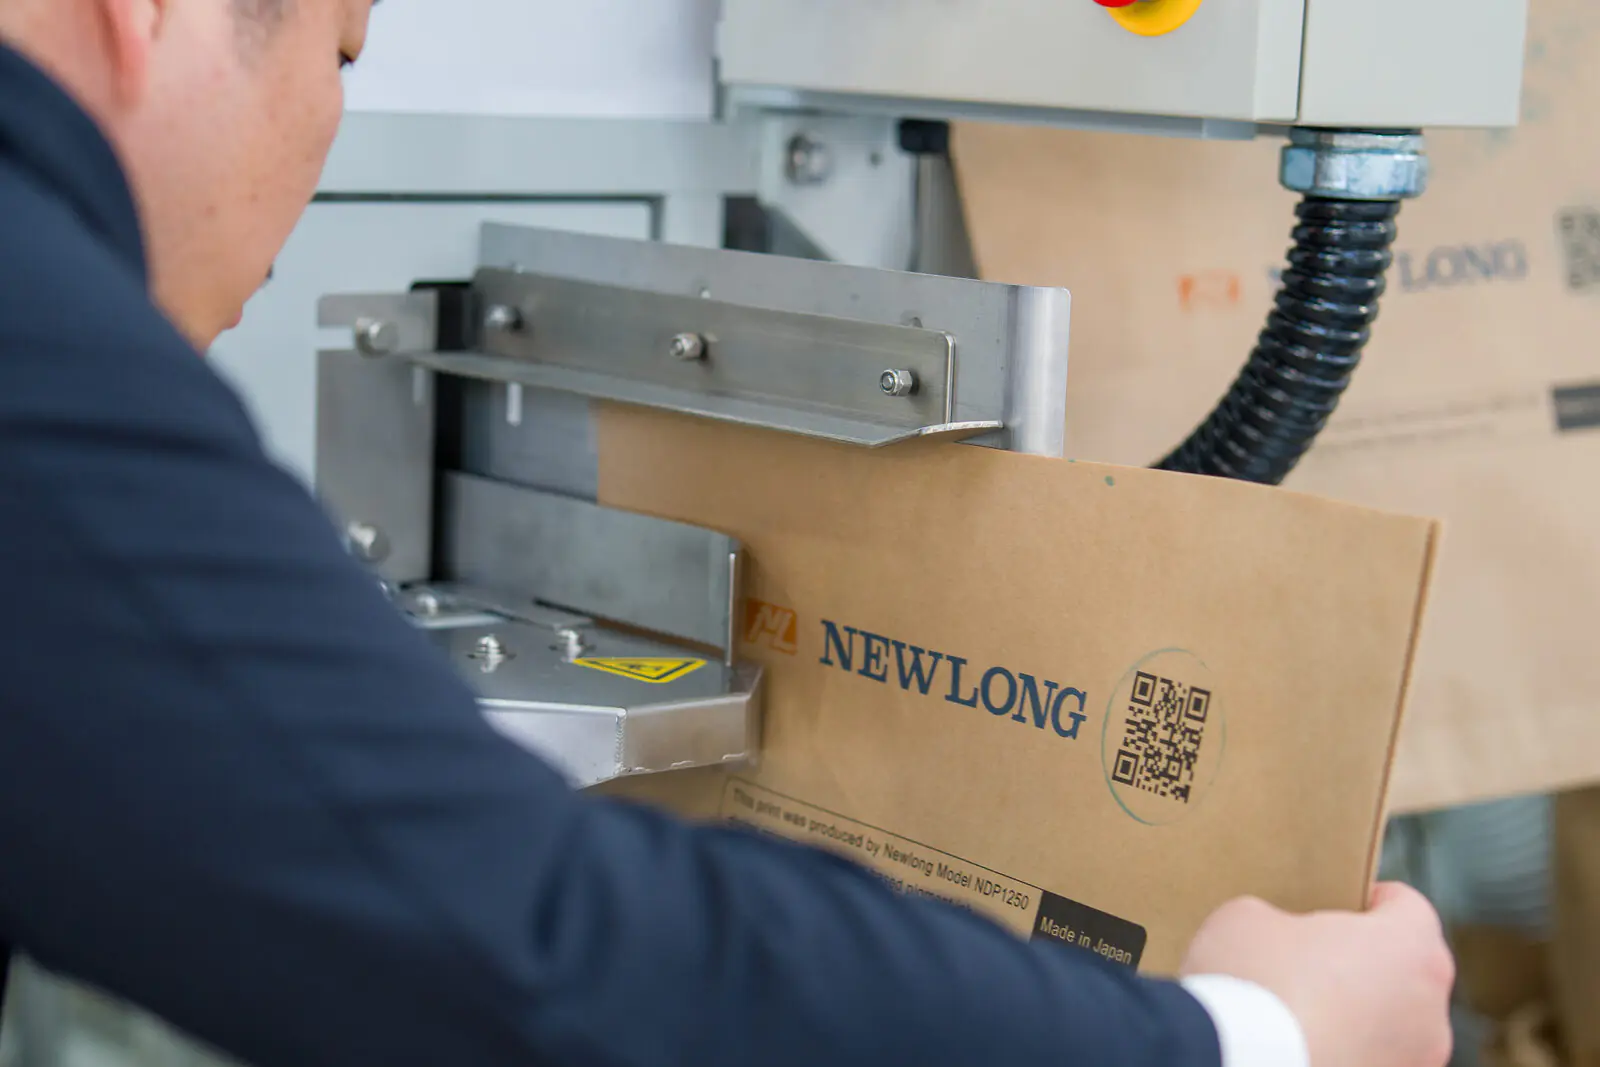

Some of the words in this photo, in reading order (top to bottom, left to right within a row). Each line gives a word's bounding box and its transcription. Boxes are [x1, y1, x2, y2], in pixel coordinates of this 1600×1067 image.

[819, 619, 1088, 740] NEWLONG
[783, 810, 807, 828] was
[808, 819, 864, 848] produced
[866, 837, 881, 857] by
[883, 843, 934, 877] Newlong
[936, 862, 973, 887] Model
[974, 877, 1030, 910] NDP1250
[1040, 916, 1075, 943] Made
[1078, 930, 1091, 948] in
[1093, 938, 1132, 965] Japan
